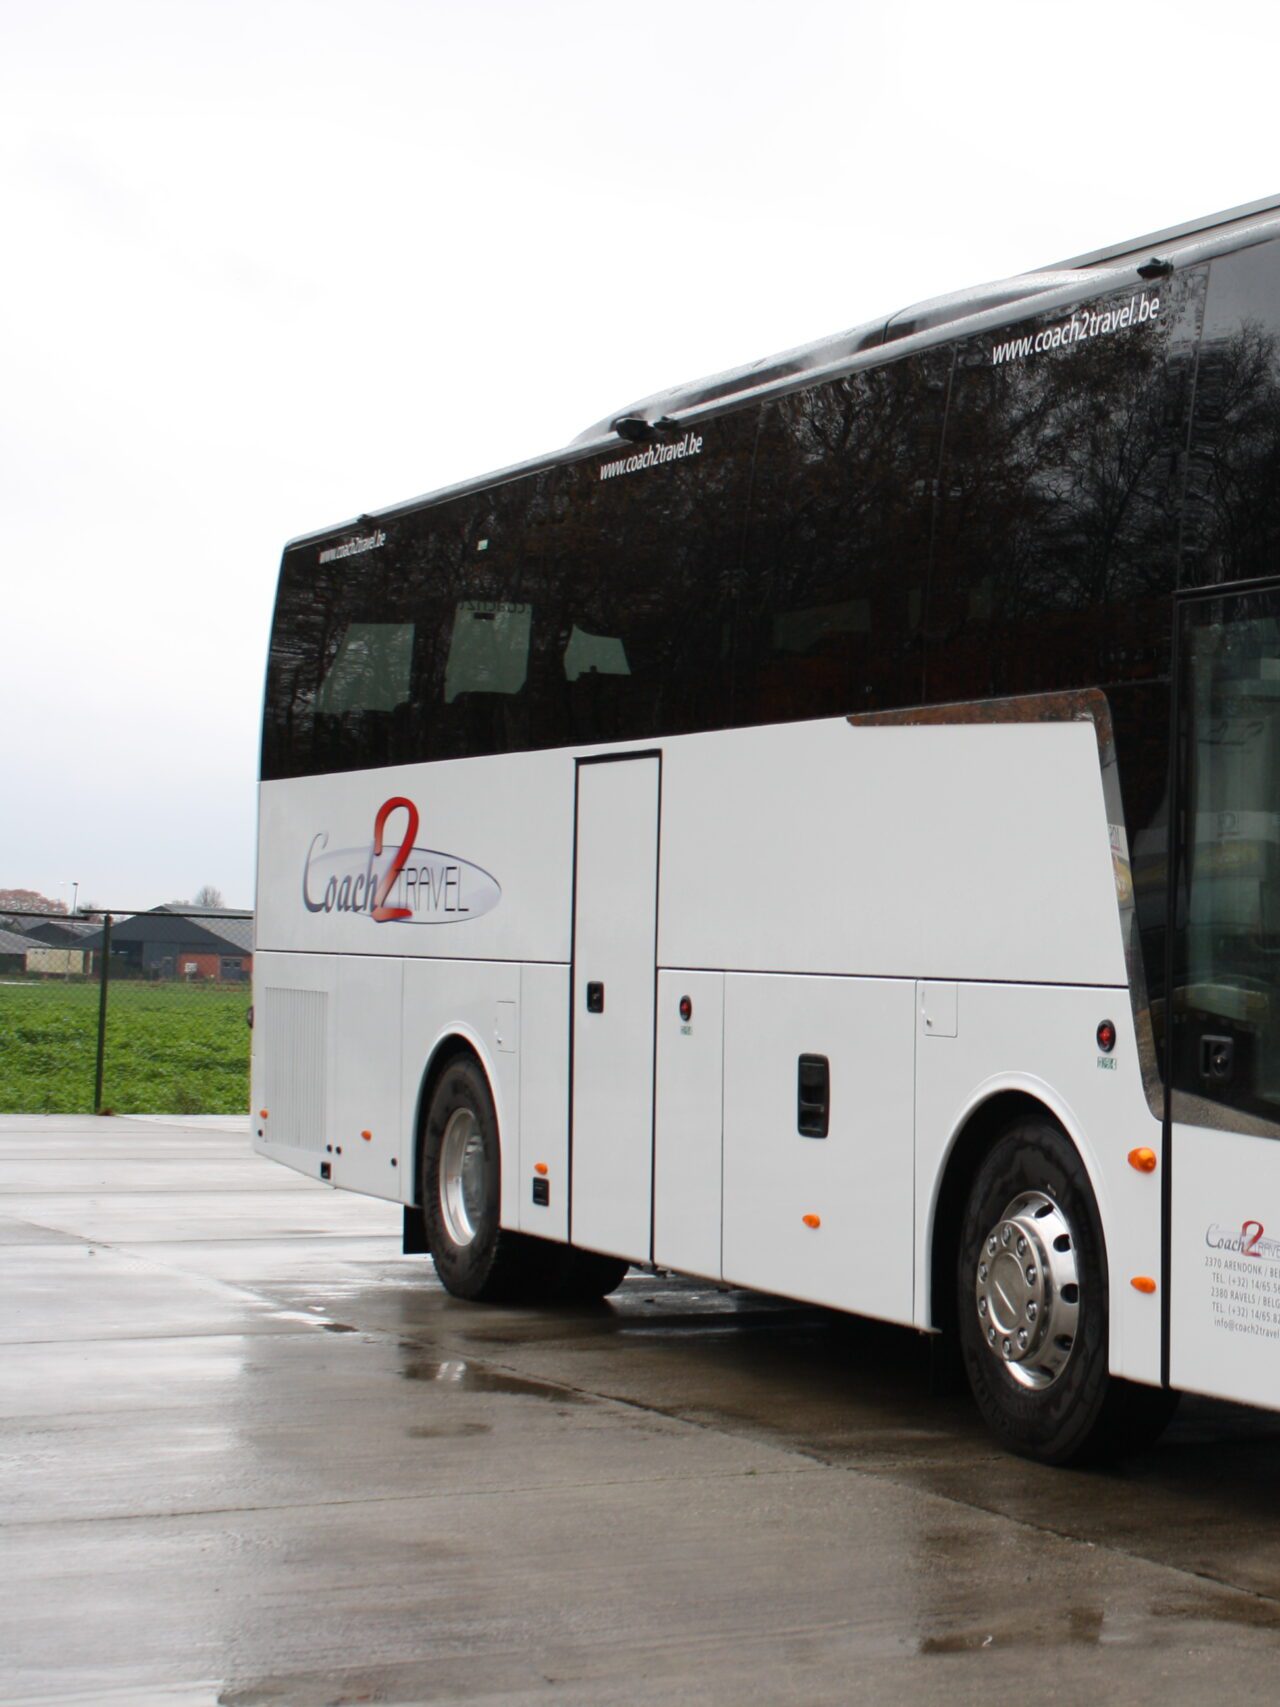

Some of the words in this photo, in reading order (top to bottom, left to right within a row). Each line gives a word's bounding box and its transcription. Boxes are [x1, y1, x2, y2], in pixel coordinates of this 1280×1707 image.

[992, 293, 1160, 365] www.coach2travel.be
[600, 432, 703, 480] www.coach2travel.be
[1204, 1256, 1222, 1268] 2370
[1224, 1259, 1263, 1276] ARENDONK
[1228, 1274, 1249, 1289] (+32)
[1211, 1286, 1228, 1300] 2380
[1230, 1289, 1256, 1305] RAVELS
[1228, 1303, 1249, 1319] (+32)
